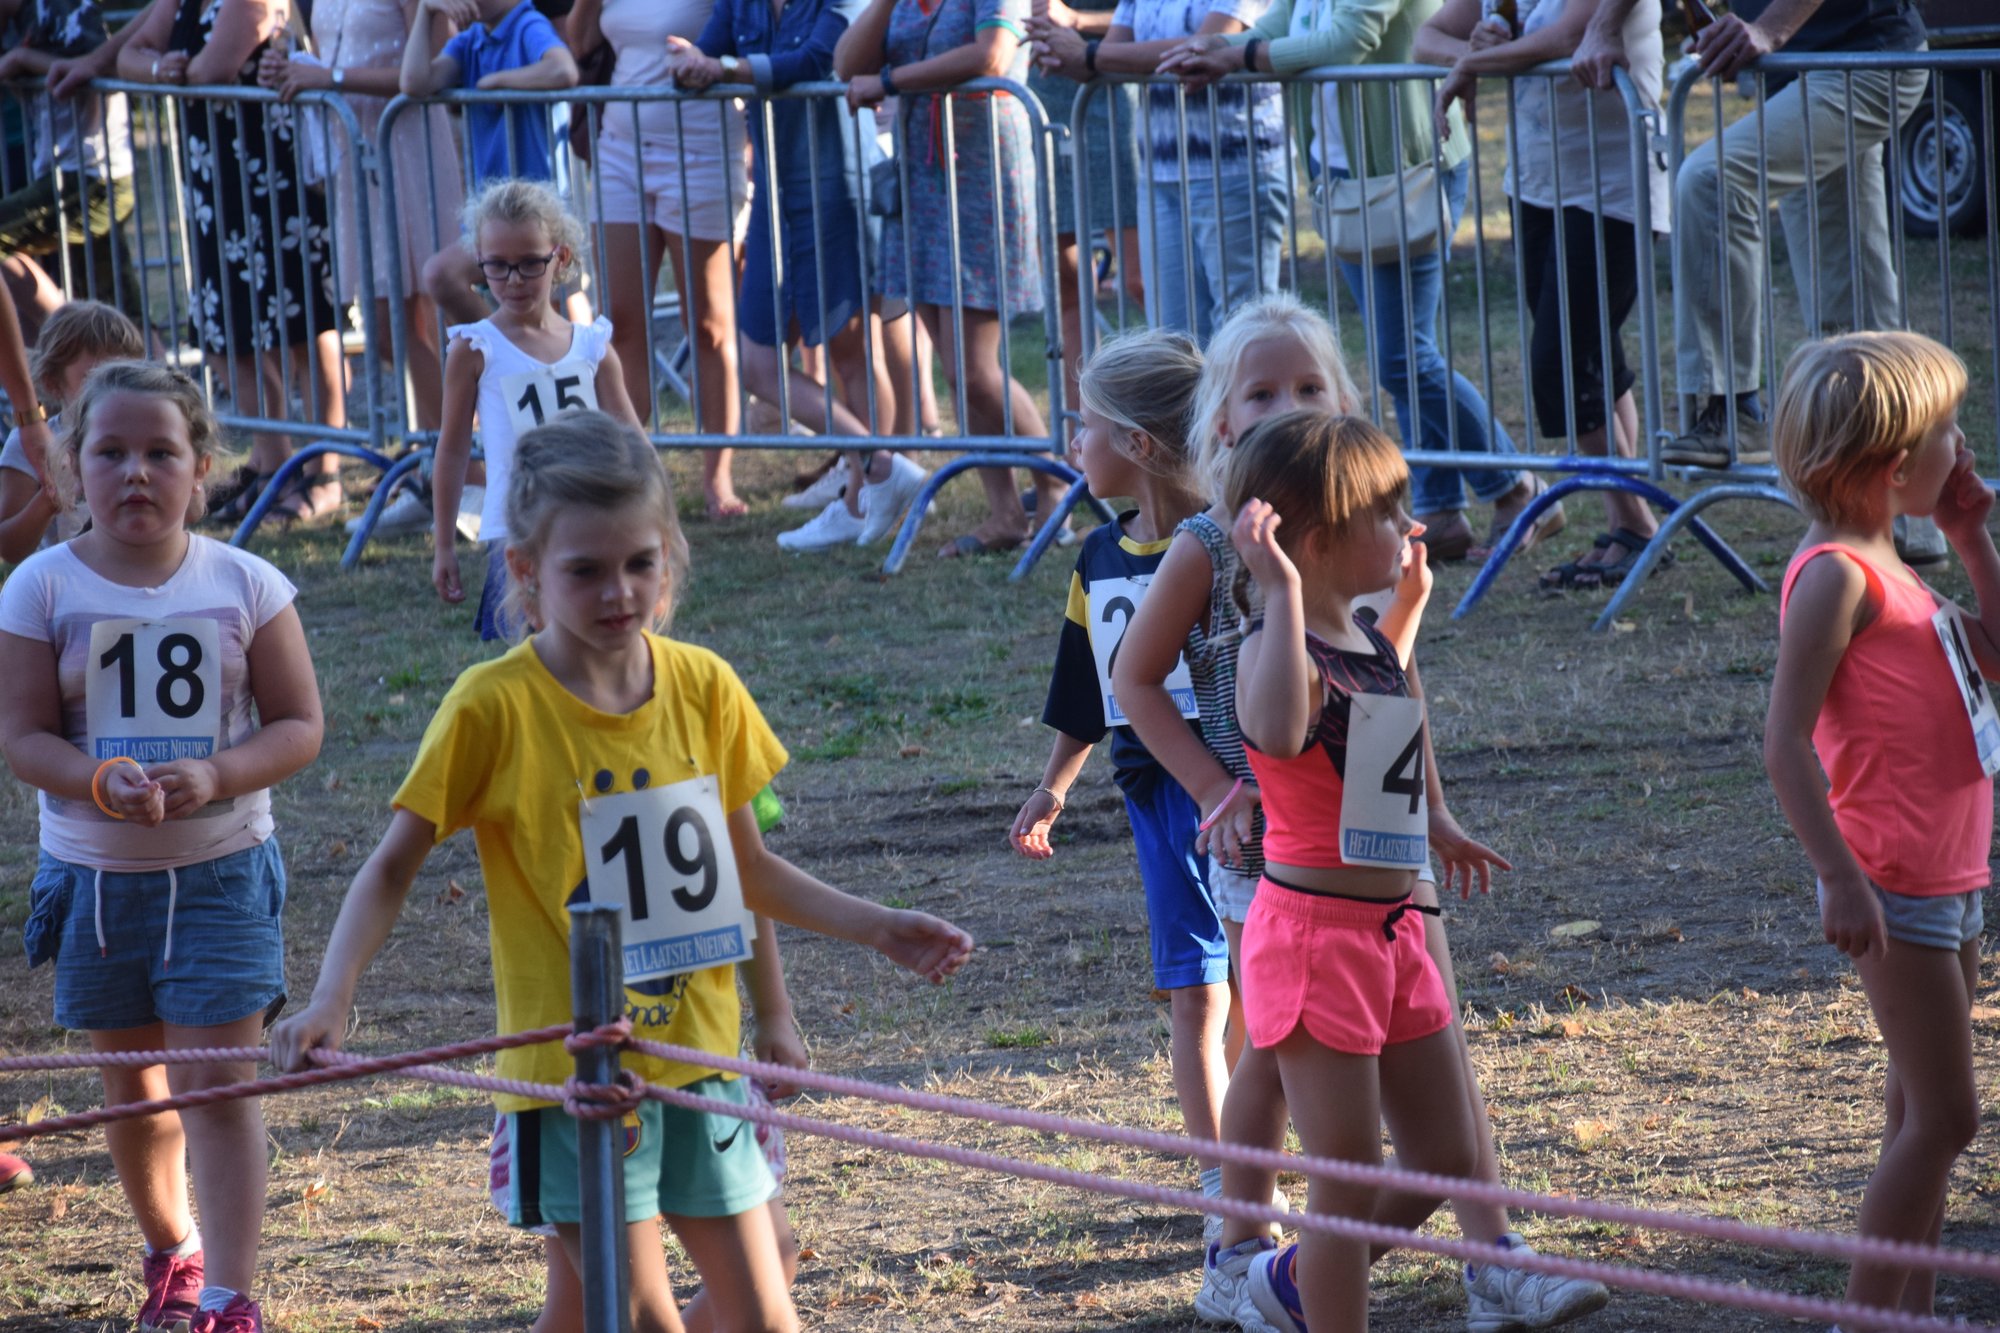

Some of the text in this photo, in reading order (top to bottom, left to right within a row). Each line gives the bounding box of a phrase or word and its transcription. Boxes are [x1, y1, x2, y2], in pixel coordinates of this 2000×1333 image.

[517, 374, 588, 427] 15
[100, 632, 205, 719] 18
[101, 738, 209, 761] HET LAATSTE NIEUWS
[1381, 720, 1424, 815] 4
[601, 805, 719, 922] 19
[1348, 831, 1371, 857] HET
[1371, 833, 1409, 861] LAATSTE
[640, 939, 695, 971] LAATSTE
[694, 931, 738, 962] NIEUWS
